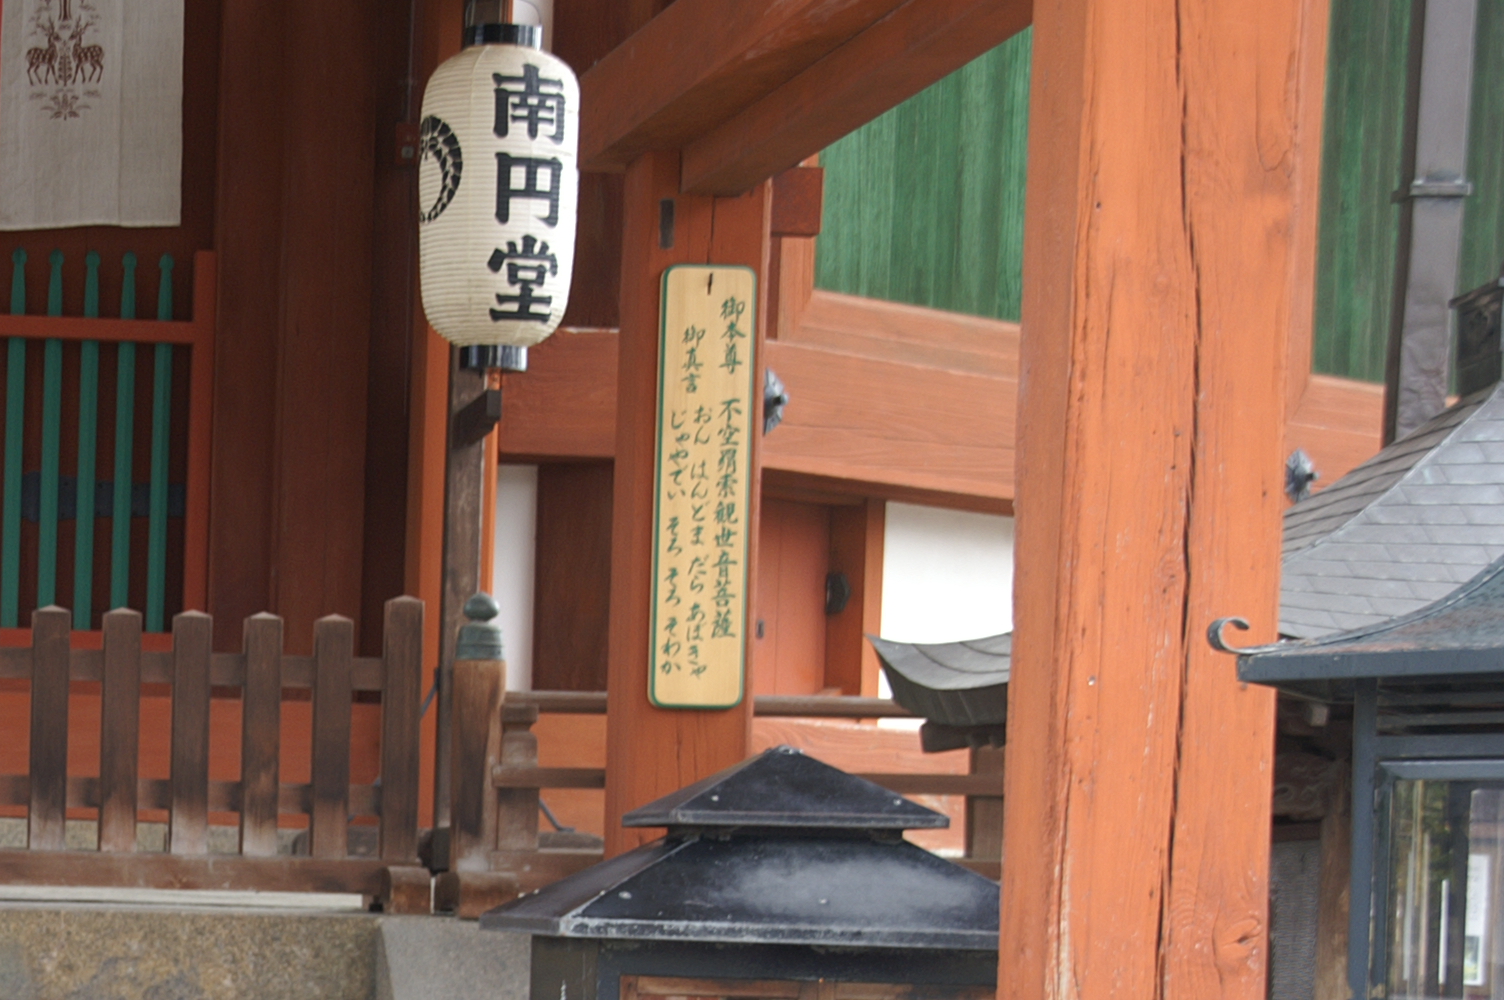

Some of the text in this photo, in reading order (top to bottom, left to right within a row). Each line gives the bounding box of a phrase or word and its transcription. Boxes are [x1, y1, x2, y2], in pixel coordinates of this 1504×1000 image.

[487, 63, 566, 324] 南円堂
[682, 325, 705, 392] 御真言
[719, 297, 746, 374] 御本尊
